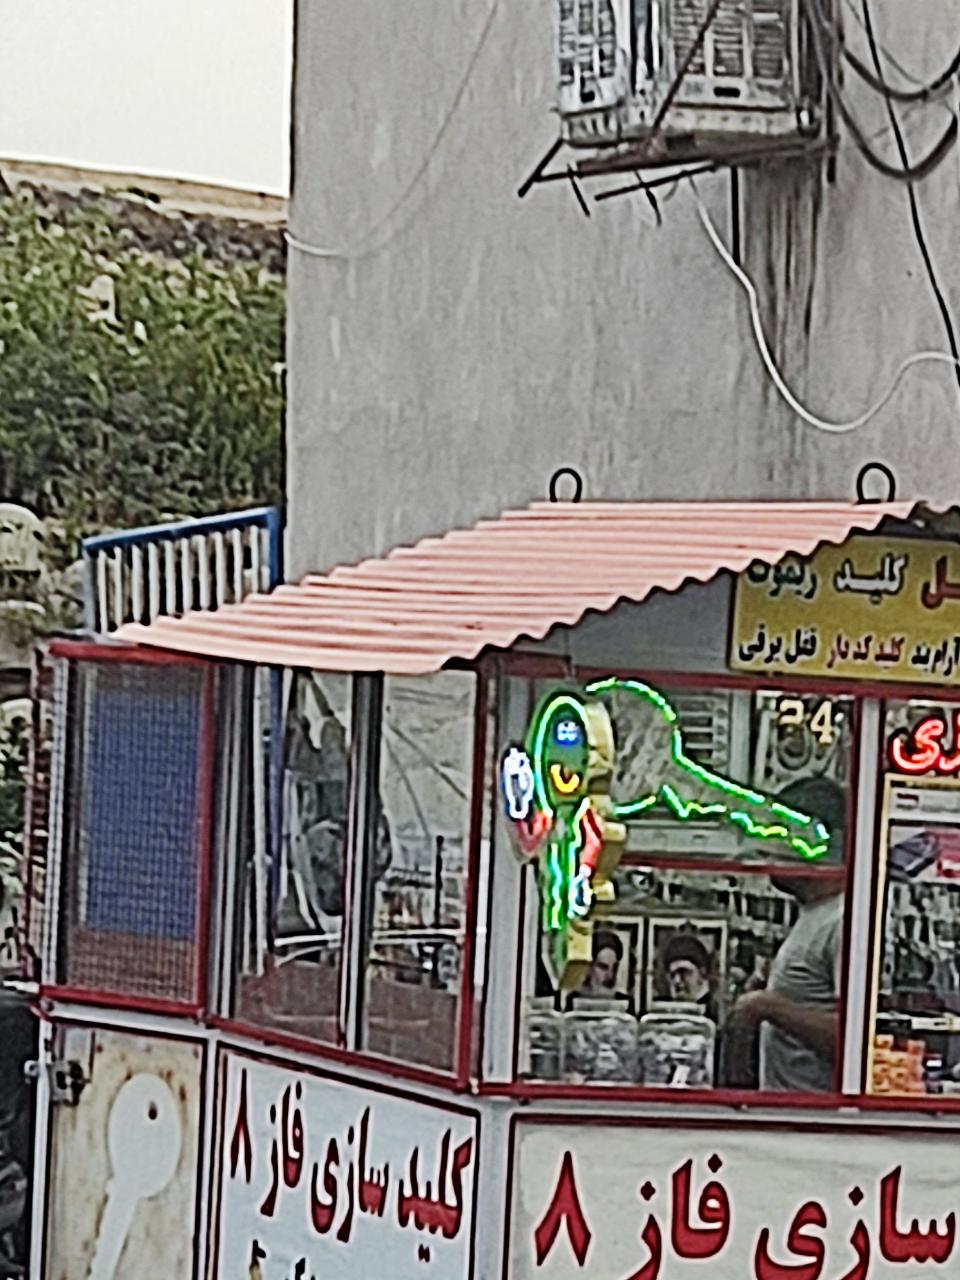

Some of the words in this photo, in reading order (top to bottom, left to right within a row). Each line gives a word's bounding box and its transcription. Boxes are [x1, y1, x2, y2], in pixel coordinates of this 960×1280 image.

[834, 552, 907, 605] کلید
[785, 627, 817, 664] قفل
[875, 636, 905, 670] کلید
[230, 1067, 253, 1184] ۸
[260, 1080, 304, 1218] فاز
[311, 1106, 390, 1244] سازی
[397, 1128, 473, 1263] کلید
[534, 1150, 592, 1267] ۸
